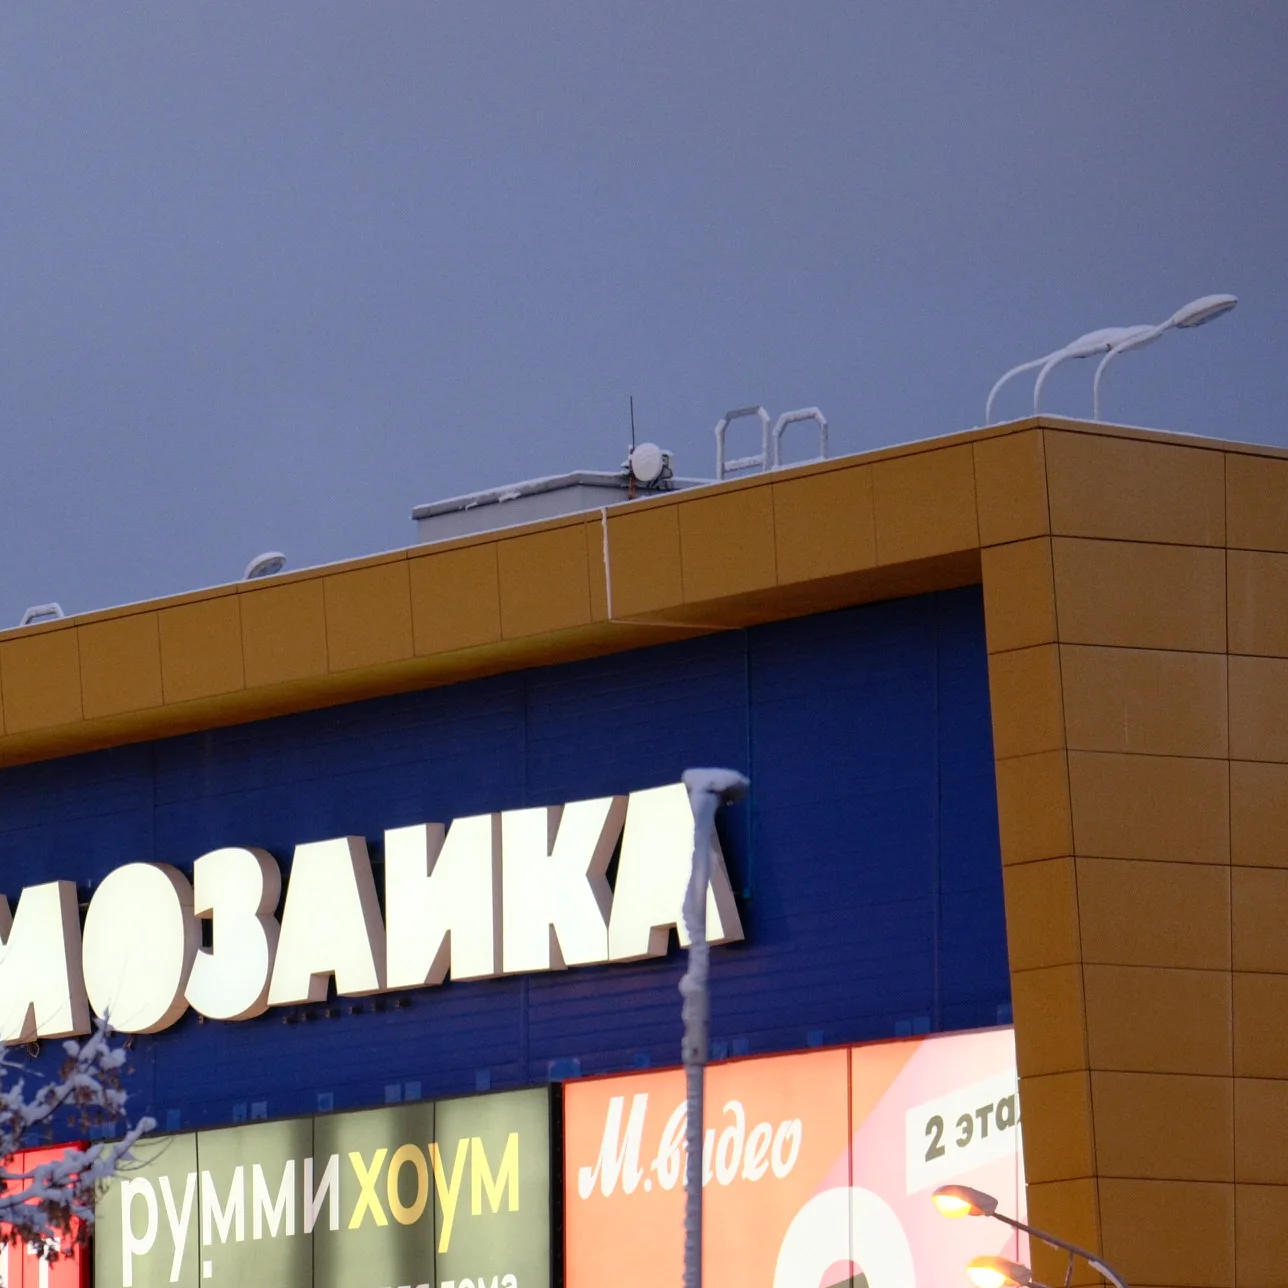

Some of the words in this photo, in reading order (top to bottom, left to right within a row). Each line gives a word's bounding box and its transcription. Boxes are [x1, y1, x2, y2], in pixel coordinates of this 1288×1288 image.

[924, 1114, 946, 1163] 2
[955, 1093, 1021, 1148] эта
[121, 1132, 519, 1287] руммихоум
